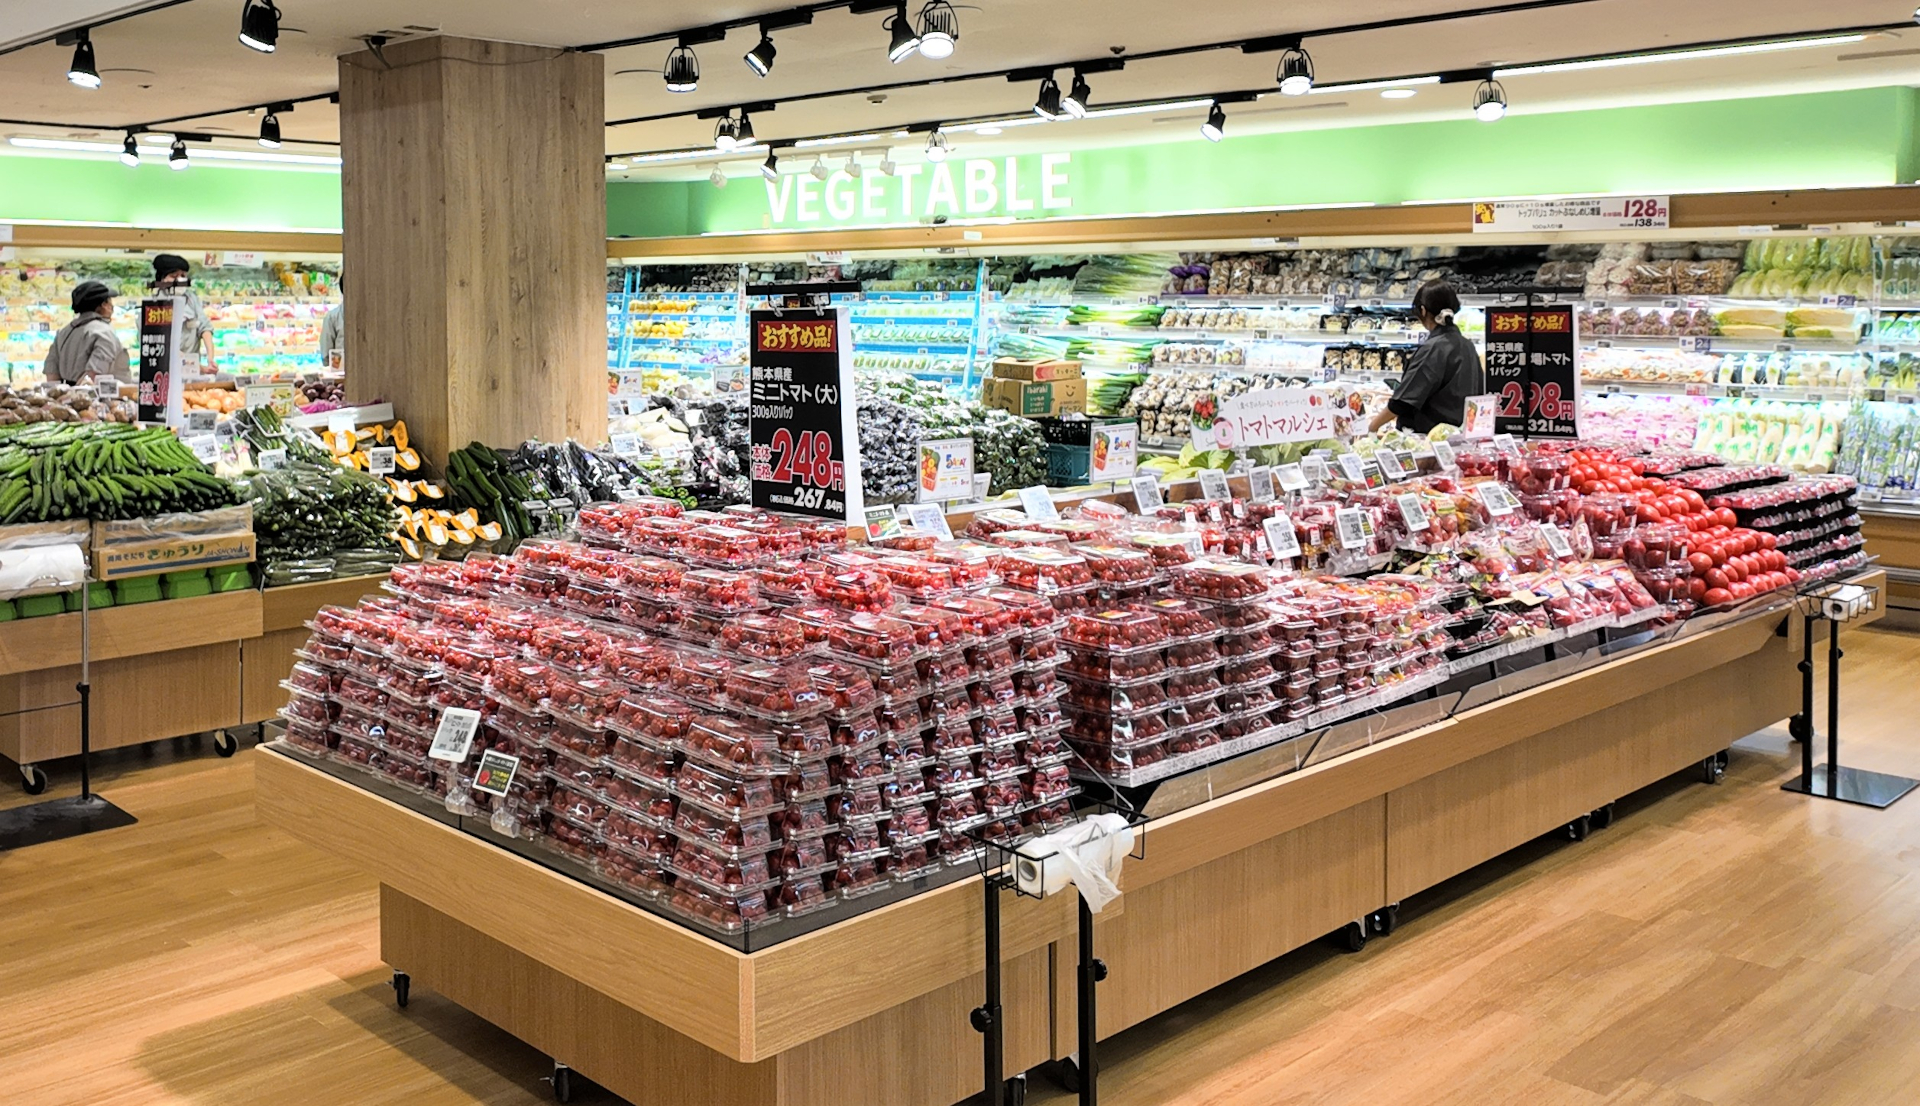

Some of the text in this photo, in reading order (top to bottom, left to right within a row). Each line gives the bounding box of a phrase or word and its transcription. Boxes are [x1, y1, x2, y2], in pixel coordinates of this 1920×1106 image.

[764, 152, 1073, 223] VEGETABLE
[762, 323, 832, 348] おすすめ品!
[752, 366, 793, 382] 熊本県産
[1490, 366, 1521, 376] 1パック
[1238, 412, 1328, 442] トマトマルシェ
[771, 428, 845, 492] 248円
[147, 544, 204, 561] きゅうり
